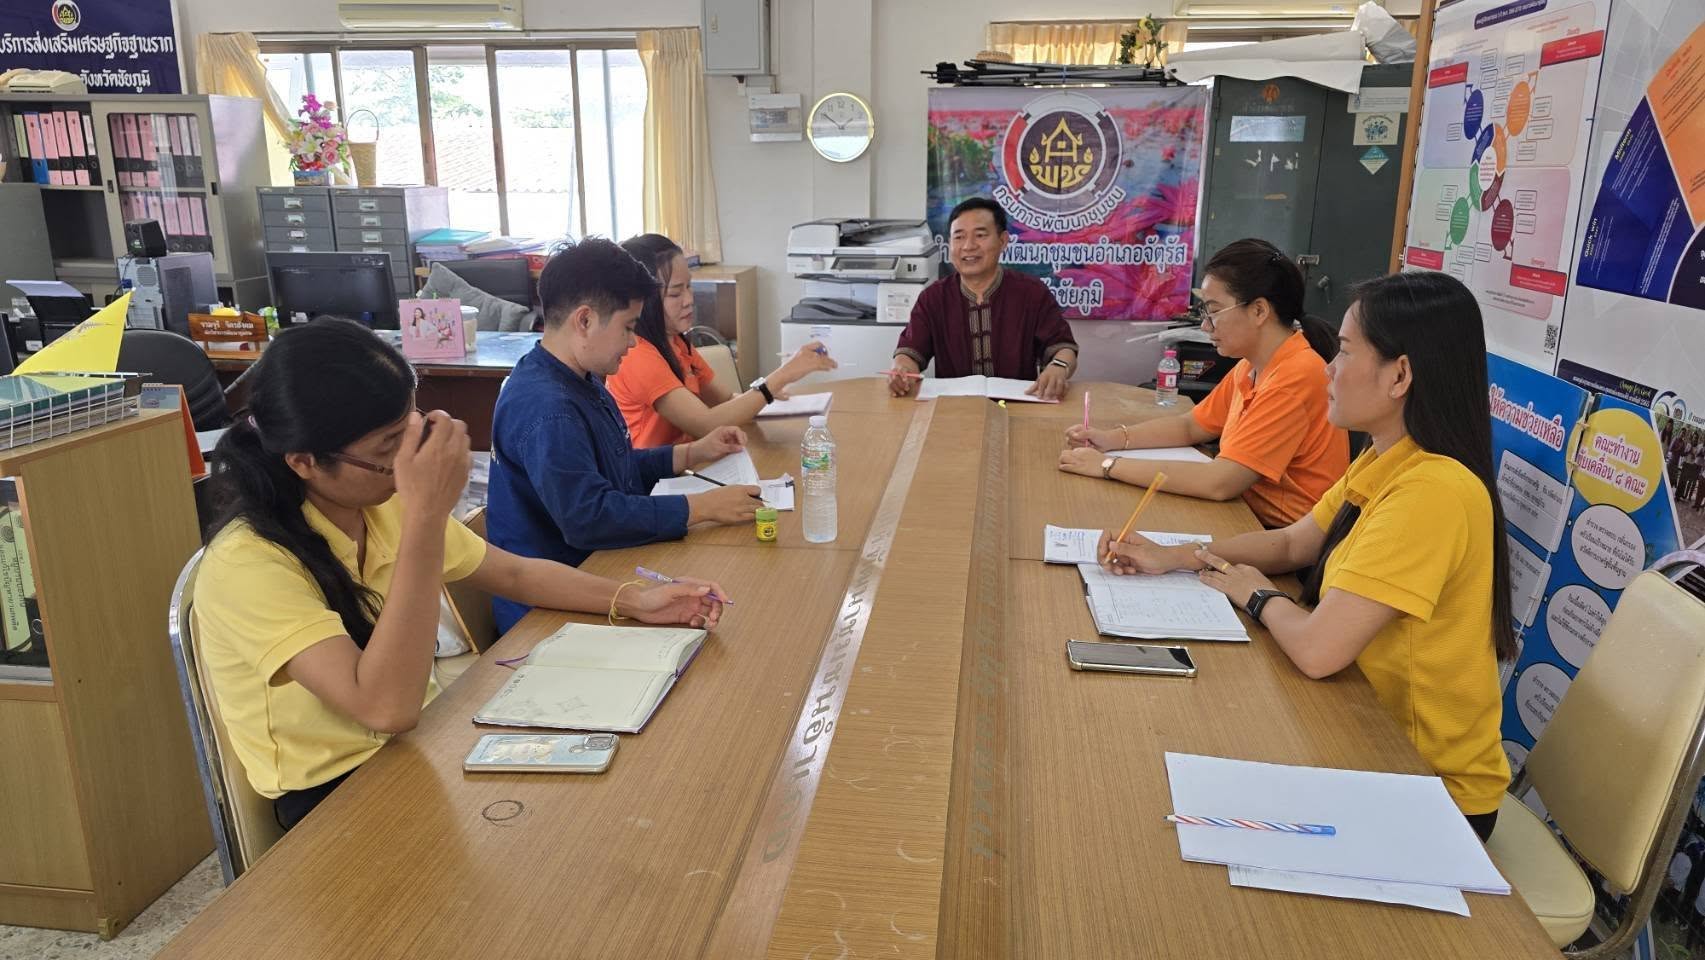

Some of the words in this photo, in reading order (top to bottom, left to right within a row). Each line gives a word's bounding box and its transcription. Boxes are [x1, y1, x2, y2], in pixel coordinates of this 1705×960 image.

[994, 186, 1124, 231] กรมการพัฒนาชุมชน
[1594, 435, 1641, 465] คณะทำงาน
[1624, 476, 1646, 496] คณะ
